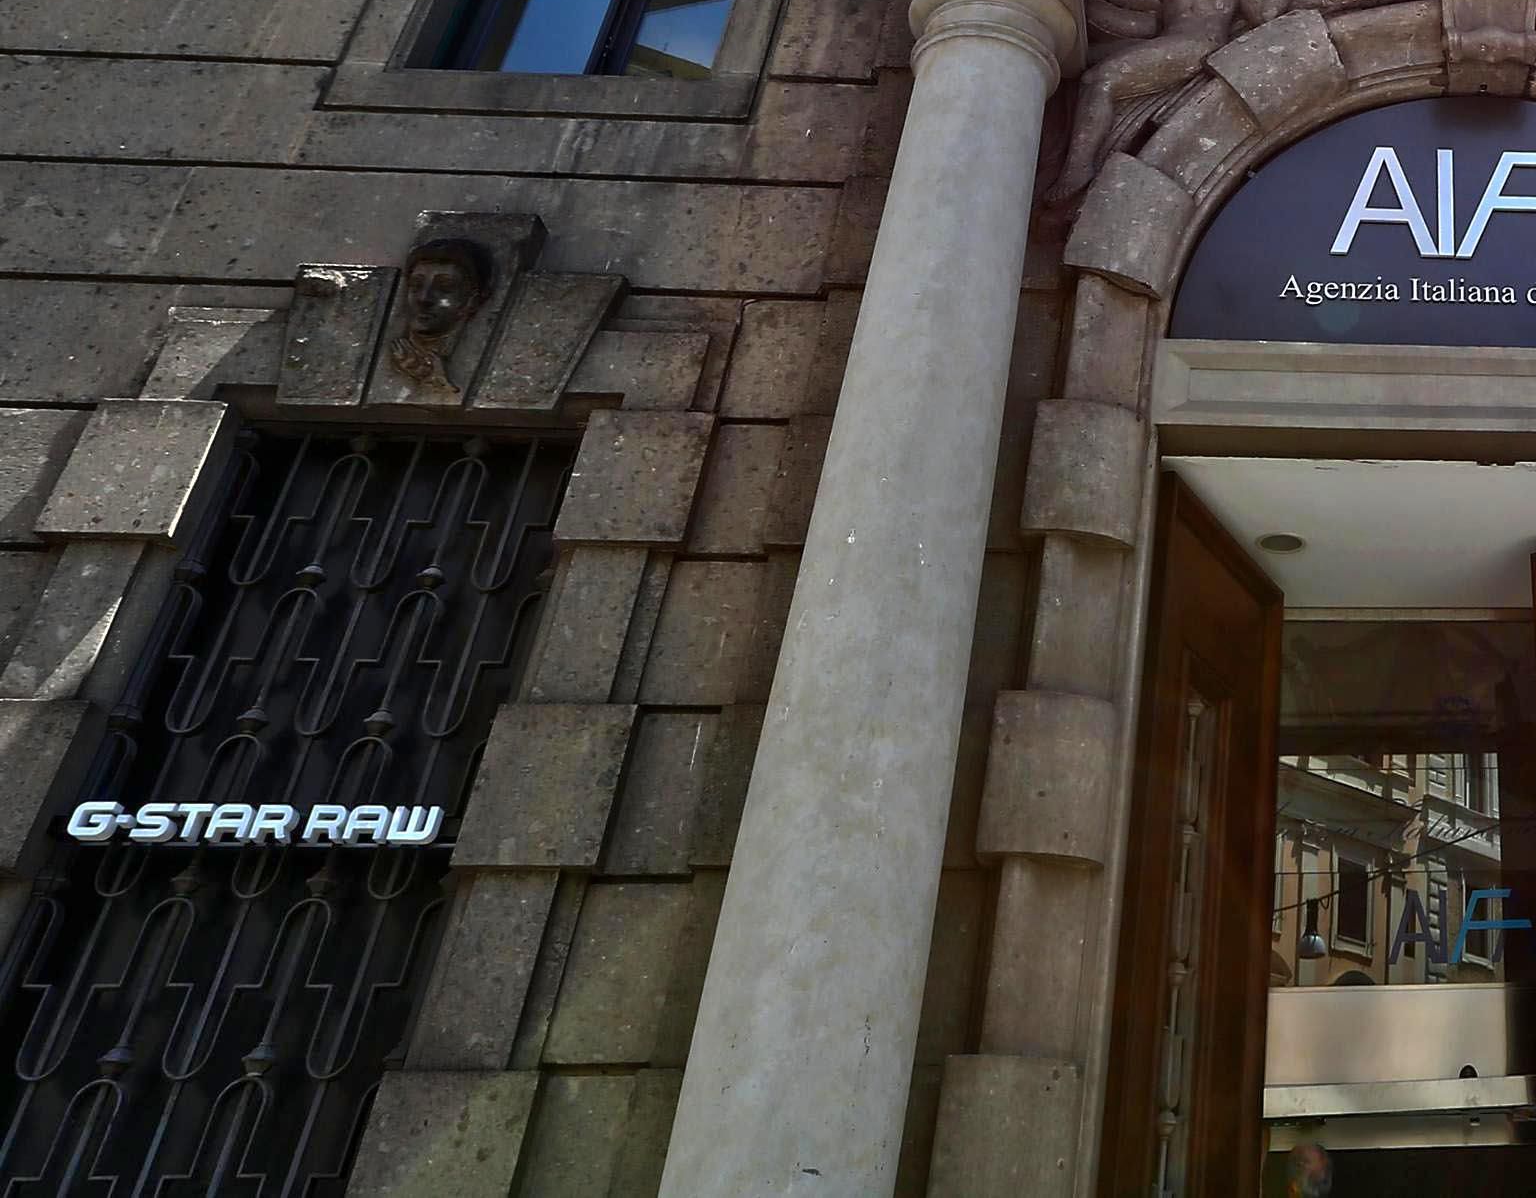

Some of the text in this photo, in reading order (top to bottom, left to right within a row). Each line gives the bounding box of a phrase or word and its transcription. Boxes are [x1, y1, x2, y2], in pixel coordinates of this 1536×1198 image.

[1279, 274, 1401, 305] Agenzia
[1409, 278, 1518, 304] Italiana
[66, 801, 444, 844] G-STAR RAW
